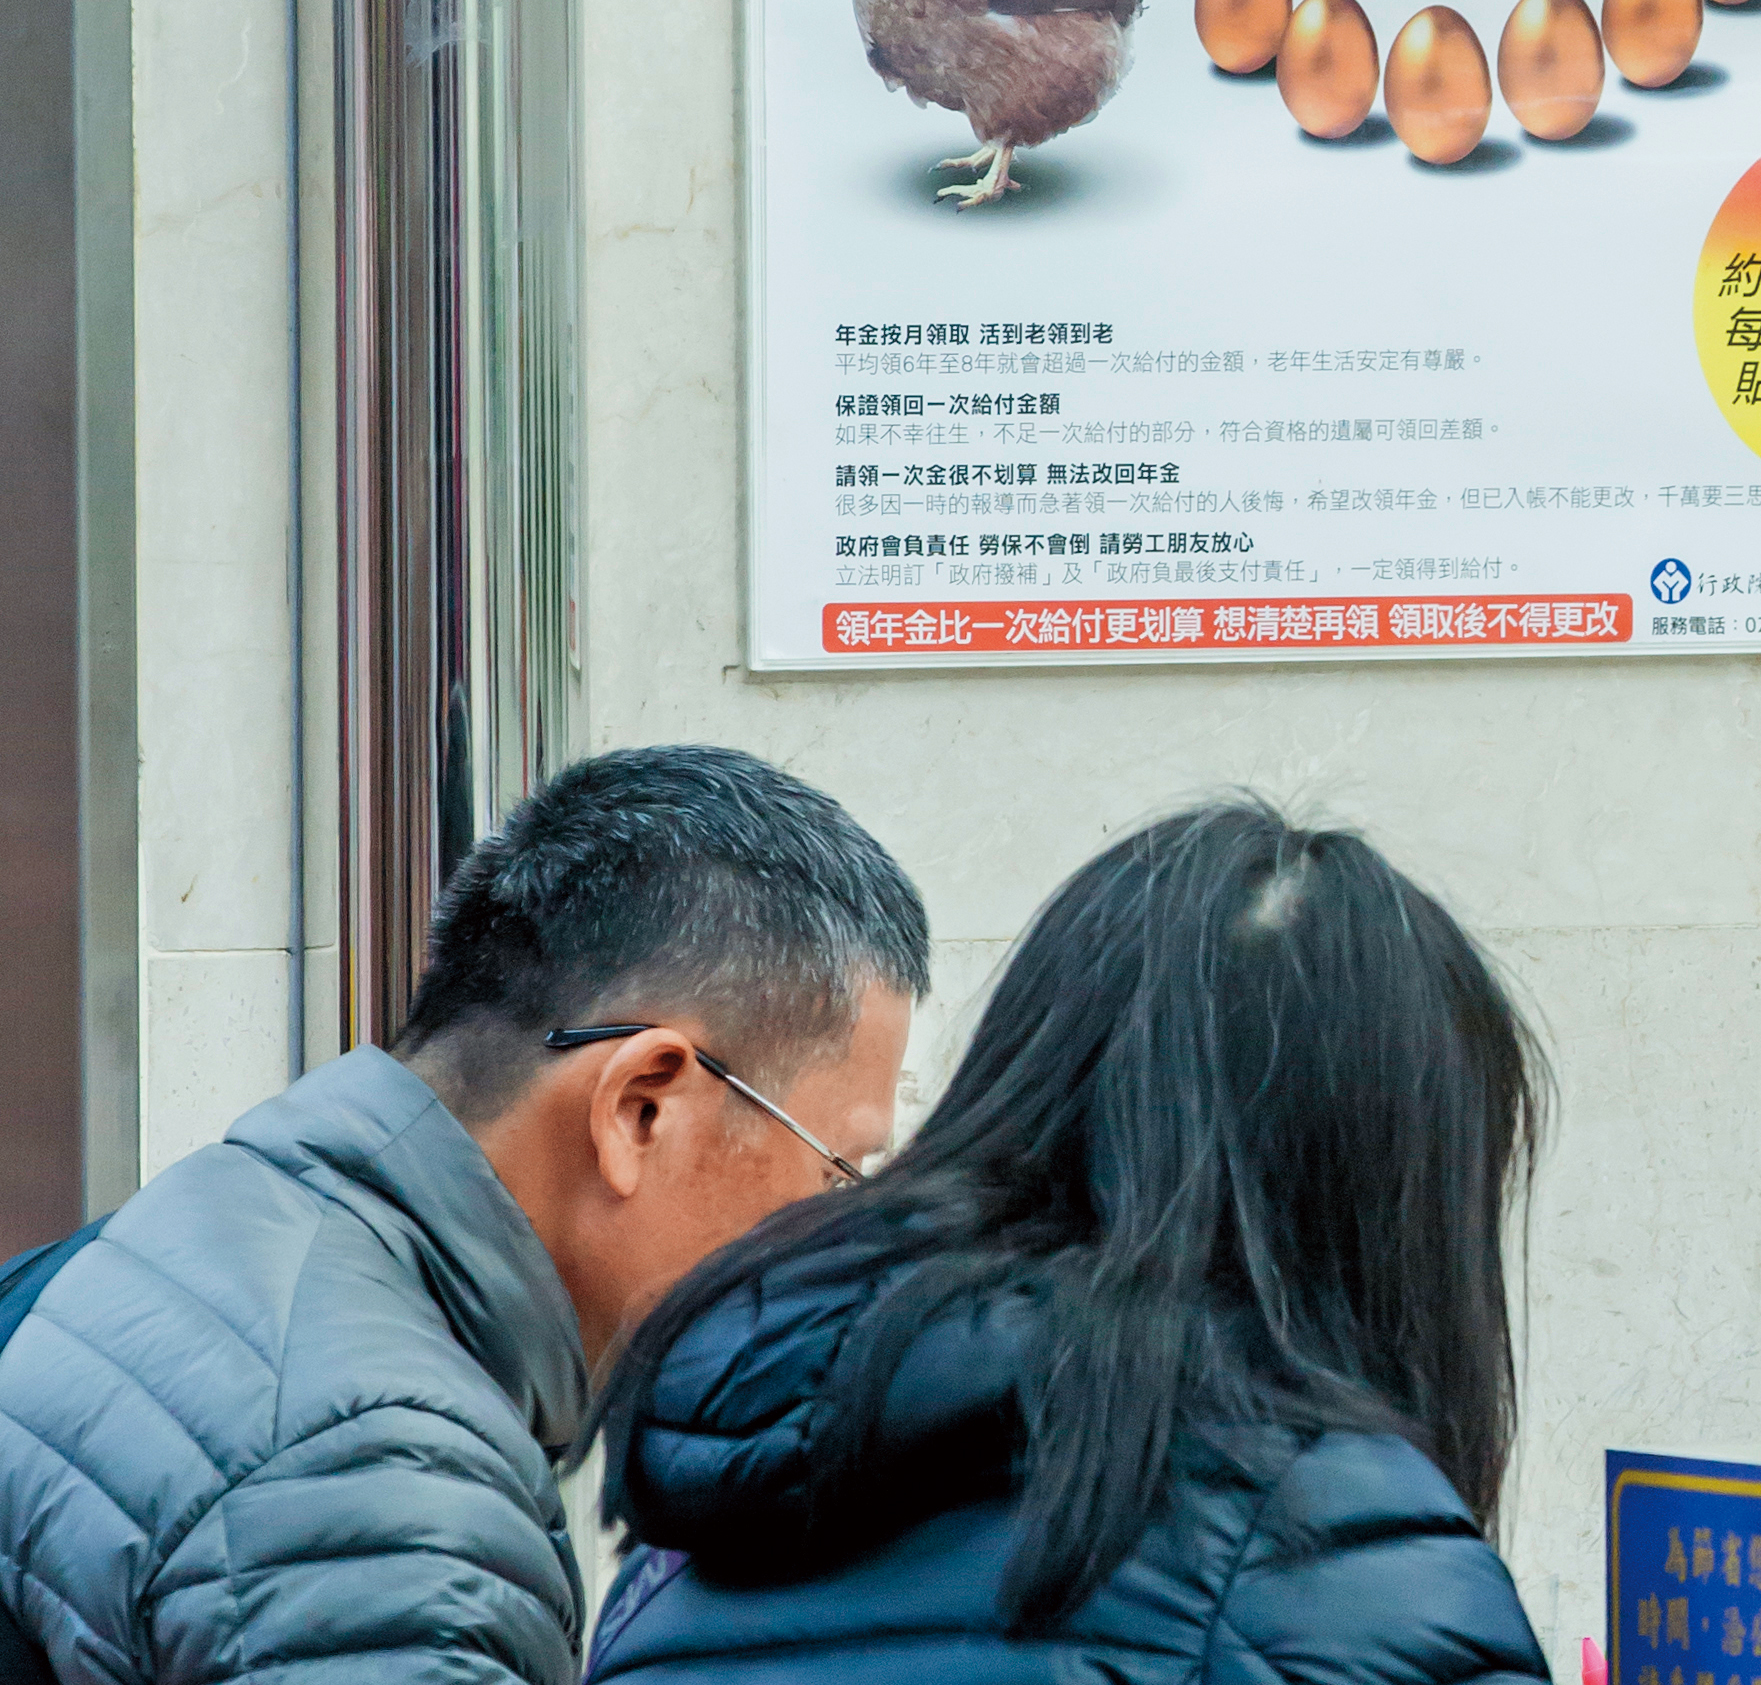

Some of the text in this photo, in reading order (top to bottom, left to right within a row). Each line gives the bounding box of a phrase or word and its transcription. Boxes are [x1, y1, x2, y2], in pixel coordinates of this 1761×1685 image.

[834, 322, 1114, 347] 年金按月領取 活到老領到老
[834, 393, 1061, 417] 保證領回一次給付金額
[835, 462, 1181, 487] 請領一次金很不划算 無法改回年金
[835, 531, 1255, 558] 政府會負責任 勞保不會倒 請勞工朋友放心
[835, 600, 1619, 647] 領年金比一次給付更划算 想清楚再領 領取後不得更改
